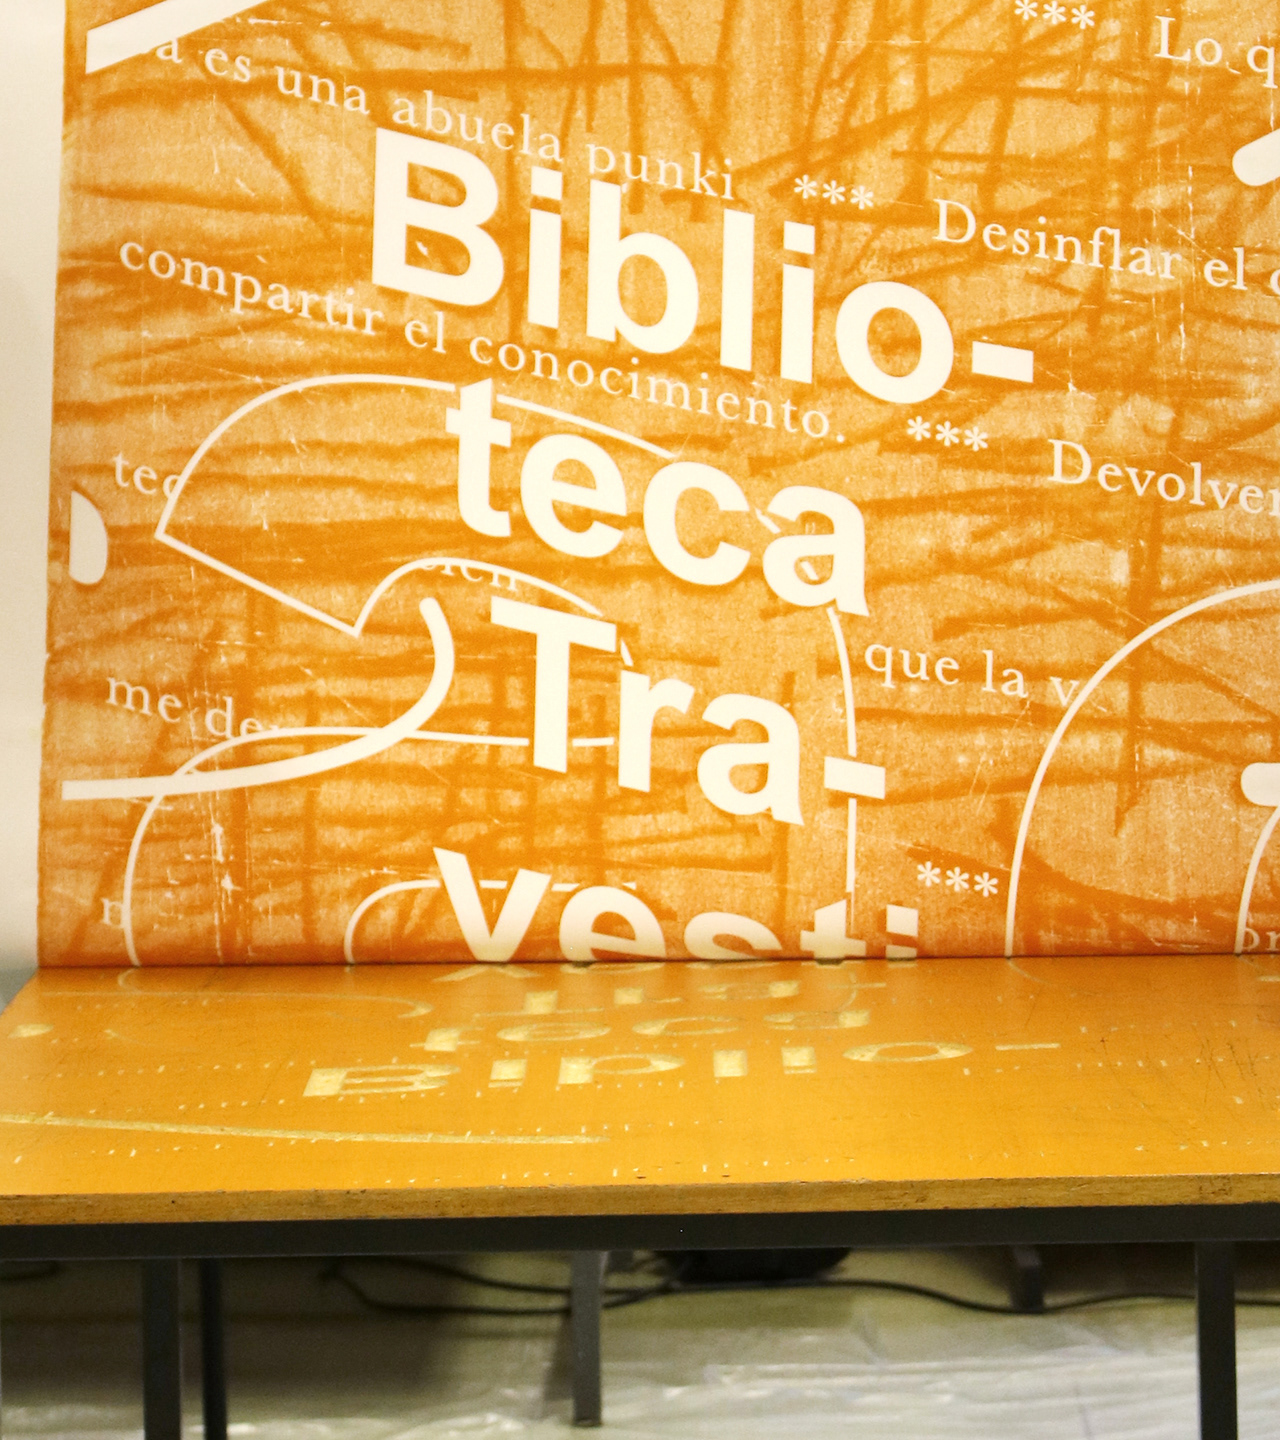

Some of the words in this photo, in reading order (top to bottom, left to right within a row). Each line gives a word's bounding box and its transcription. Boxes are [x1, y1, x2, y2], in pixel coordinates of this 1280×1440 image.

[1154, 15, 1223, 67] Lo
[205, 48, 251, 83] es
[277, 65, 370, 115] una
[392, 90, 562, 162] abuela
[587, 138, 734, 200] punki
[933, 199, 1181, 280] Desinflar
[1203, 247, 1247, 290] el
[373, 126, 1034, 404] Biblio-
[120, 241, 382, 336] compartir
[404, 312, 447, 355] el
[469, 335, 846, 443] conocimiento.
[445, 378, 869, 617] teca
[106, 677, 182, 723] me
[490, 596, 885, 826] Tra-
[865, 644, 960, 688] que
[982, 650, 1028, 698] la
